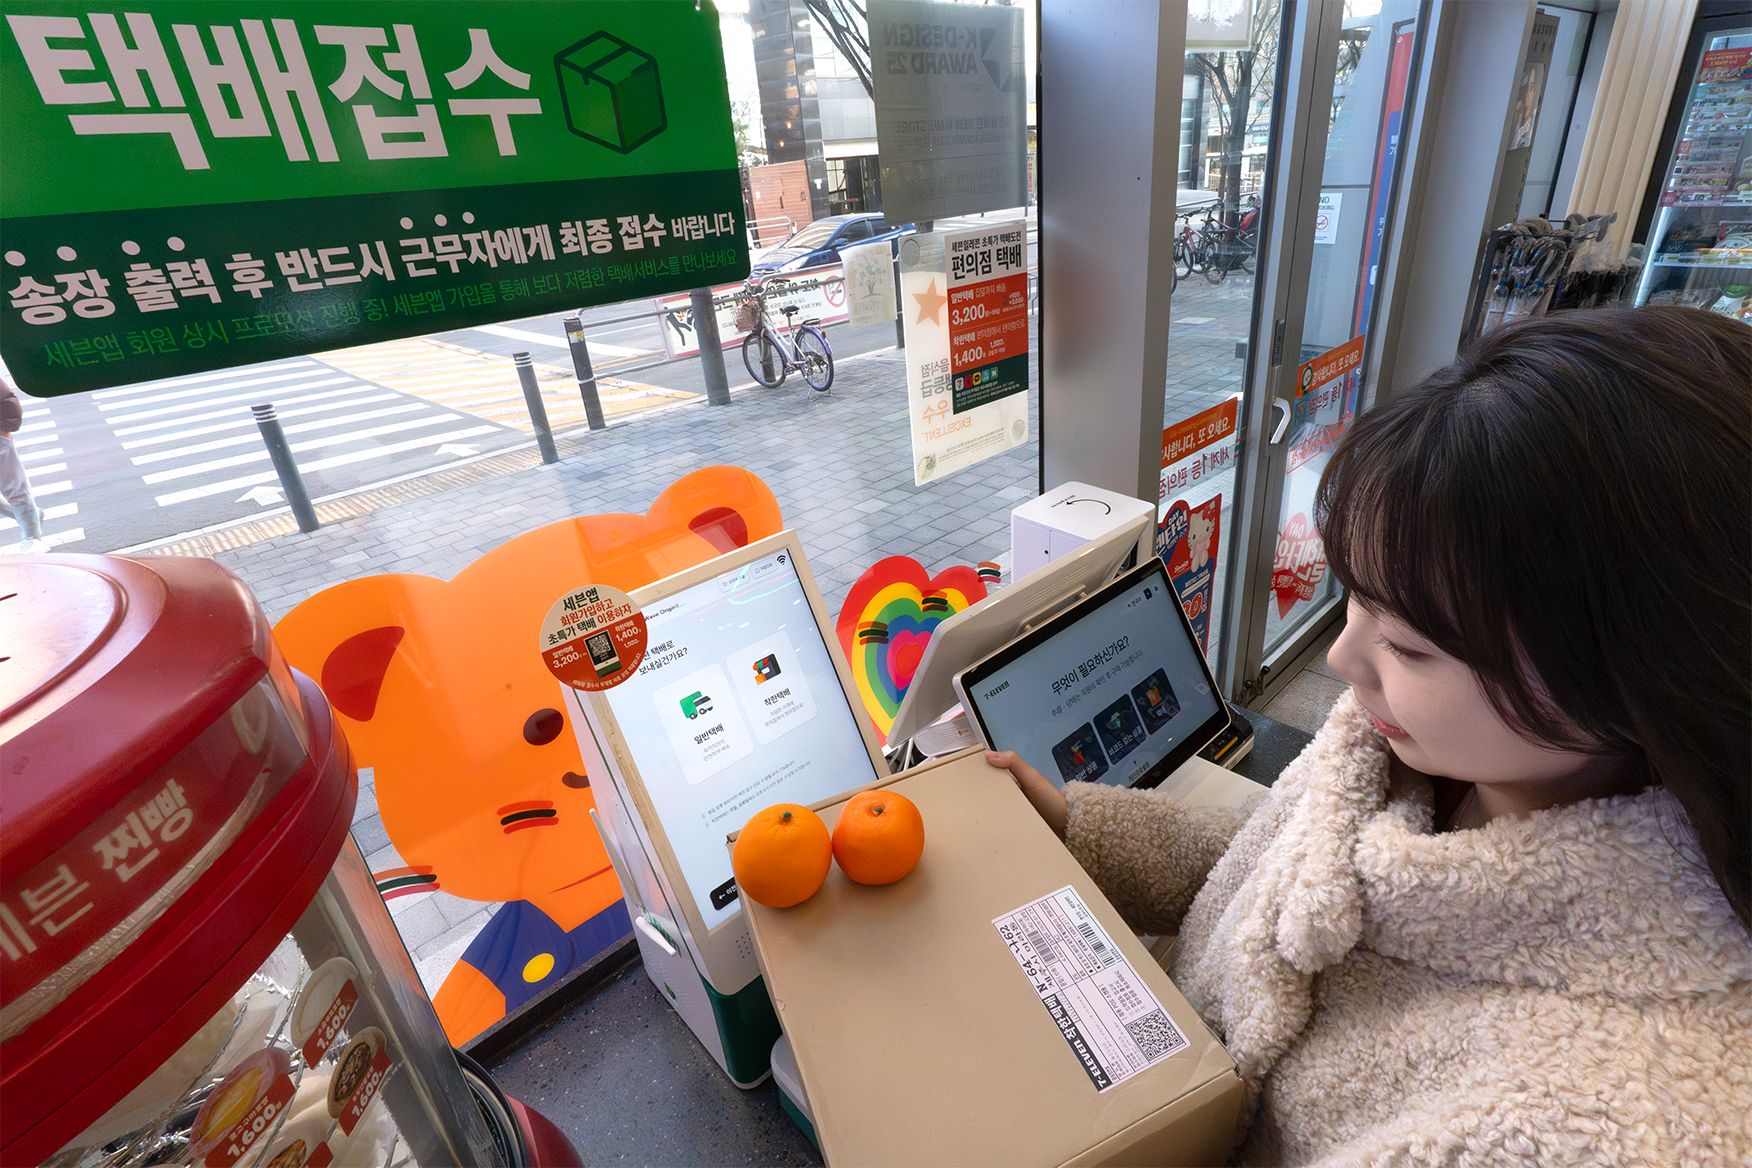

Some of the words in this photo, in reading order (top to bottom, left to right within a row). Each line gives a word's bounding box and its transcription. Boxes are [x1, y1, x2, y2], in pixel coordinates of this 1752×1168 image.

[5, 12, 543, 170] 택배접수
[982, 234, 999, 247] 초특가
[8, 269, 116, 325] 송장
[124, 258, 222, 313] 출력
[225, 253, 274, 299] 후
[275, 240, 396, 293] 반드시
[400, 224, 556, 278] 근무자에게
[559, 218, 613, 256] 최종
[617, 214, 667, 251] 접수
[671, 212, 736, 241] 바랍니다
[952, 249, 992, 280] 편의점
[996, 244, 1021, 270] 택배
[44, 333, 126, 369] 세븐앱
[126, 326, 180, 355] 회원
[183, 318, 230, 348] 상시
[232, 309, 314, 341] 프로모션
[320, 301, 361, 328] 진행
[394, 288, 445, 316] 세븐앱
[446, 281, 498, 309] 가입을
[498, 278, 531, 303] 통해
[533, 272, 562, 296] 보다
[564, 267, 606, 291] 저렴한
[607, 256, 682, 284] 택배서비스를
[683, 248, 738, 274] 만나보세요
[1161, 433, 1195, 460] 사합니다,
[1197, 428, 1206, 444] 또
[560, 598, 614, 627] 회원가입하고
[563, 587, 600, 612] 세븐앱
[548, 625, 576, 645] 초특가
[577, 617, 597, 632] 택배
[597, 603, 632, 624] 이용하자
[639, 647, 688, 676] 보내실건가요?
[1050, 668, 1080, 695] 무엇이
[1078, 635, 1130, 680] 필요하신가요?
[694, 723, 725, 745] 일반택배
[93, 778, 194, 883] 찐빵
[1008, 921, 1032, 952] 아라동
[998, 924, 1048, 993] N-64-나62
[1030, 954, 1055, 988] 제주시
[1042, 994, 1080, 1040] 착한택배
